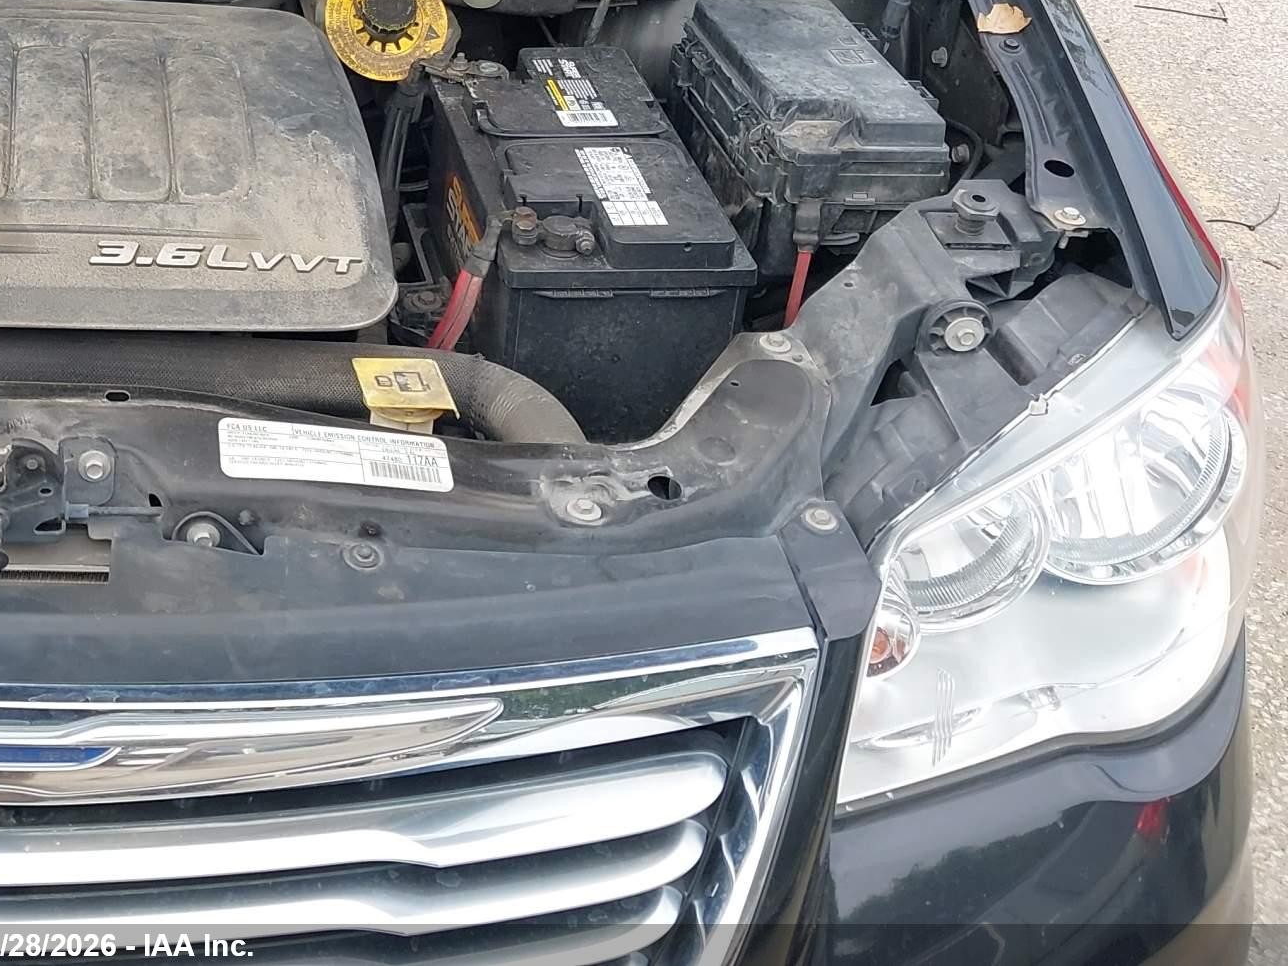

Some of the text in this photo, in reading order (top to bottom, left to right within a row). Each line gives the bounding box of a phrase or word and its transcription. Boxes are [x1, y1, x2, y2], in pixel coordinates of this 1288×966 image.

[294, 428, 321, 438] VEHICLE
[323, 431, 355, 441] EMISSION
[357, 434, 388, 444] CONTROL
[389, 437, 435, 448] INFORMATION
